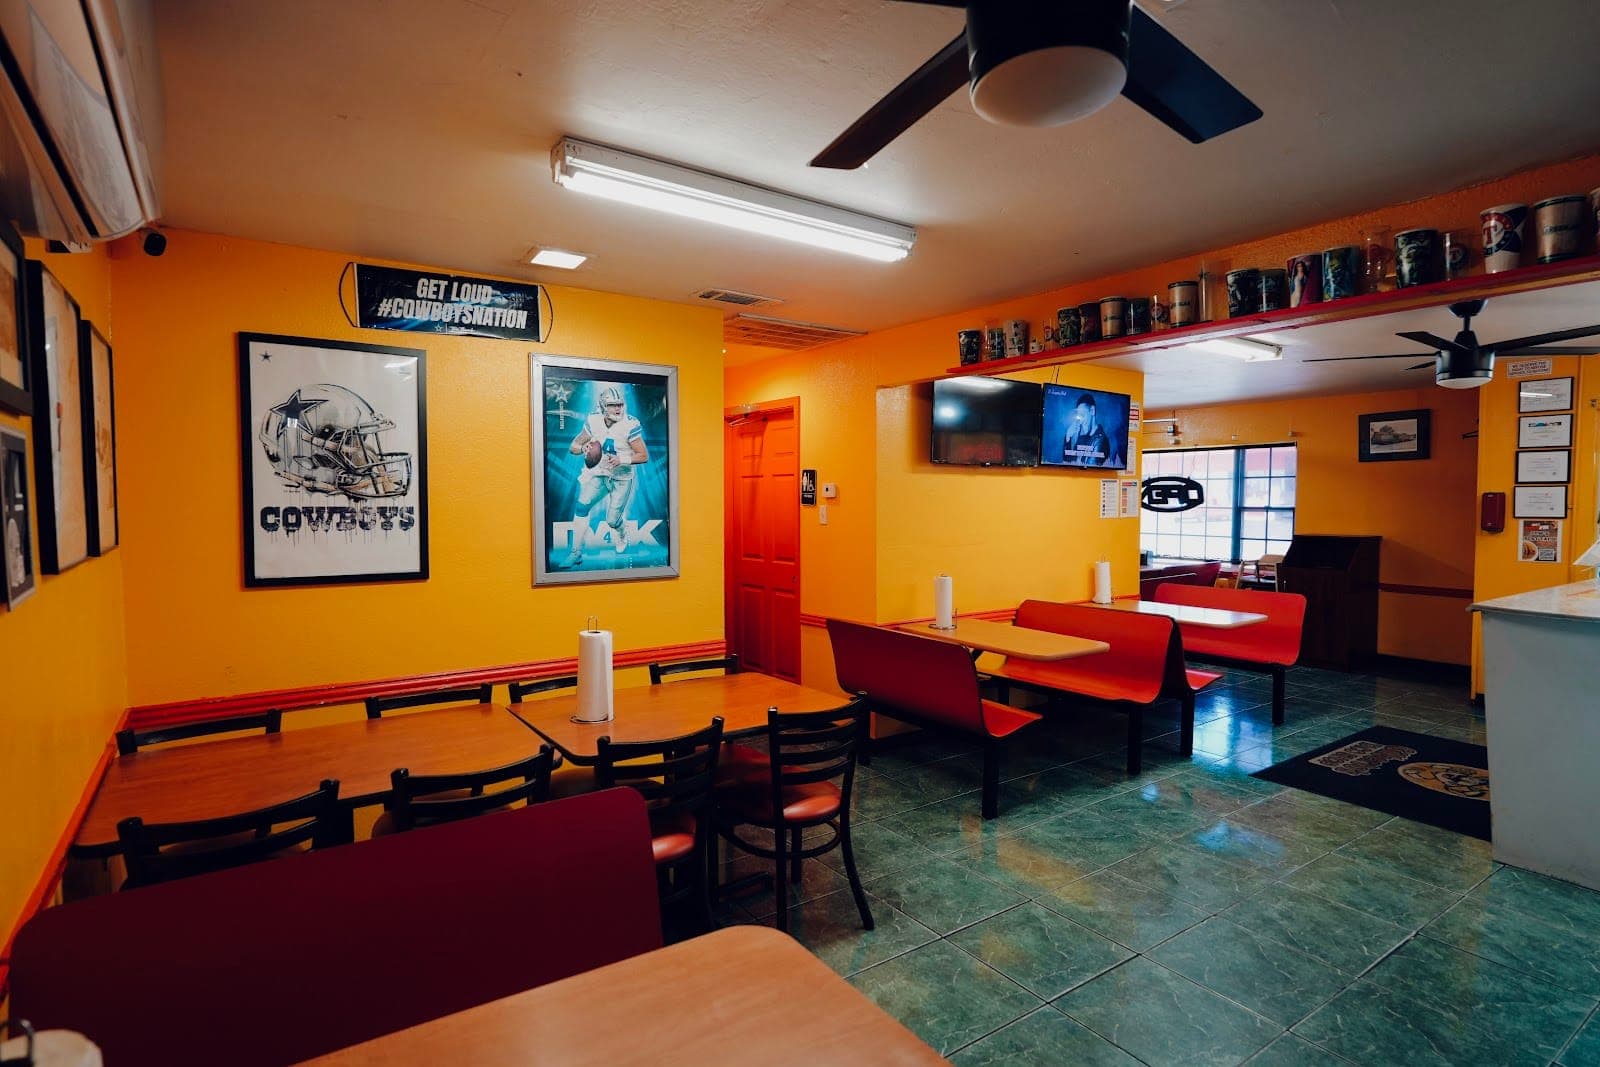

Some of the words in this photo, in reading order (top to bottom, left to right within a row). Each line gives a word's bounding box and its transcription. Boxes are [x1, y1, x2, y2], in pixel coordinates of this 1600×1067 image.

[416, 278, 448, 300] GET
[451, 281, 493, 305] LOUD
[377, 297, 528, 330] #COWBOYSNATION
[602, 438, 617, 456] 4
[259, 505, 415, 533] COWBOYS
